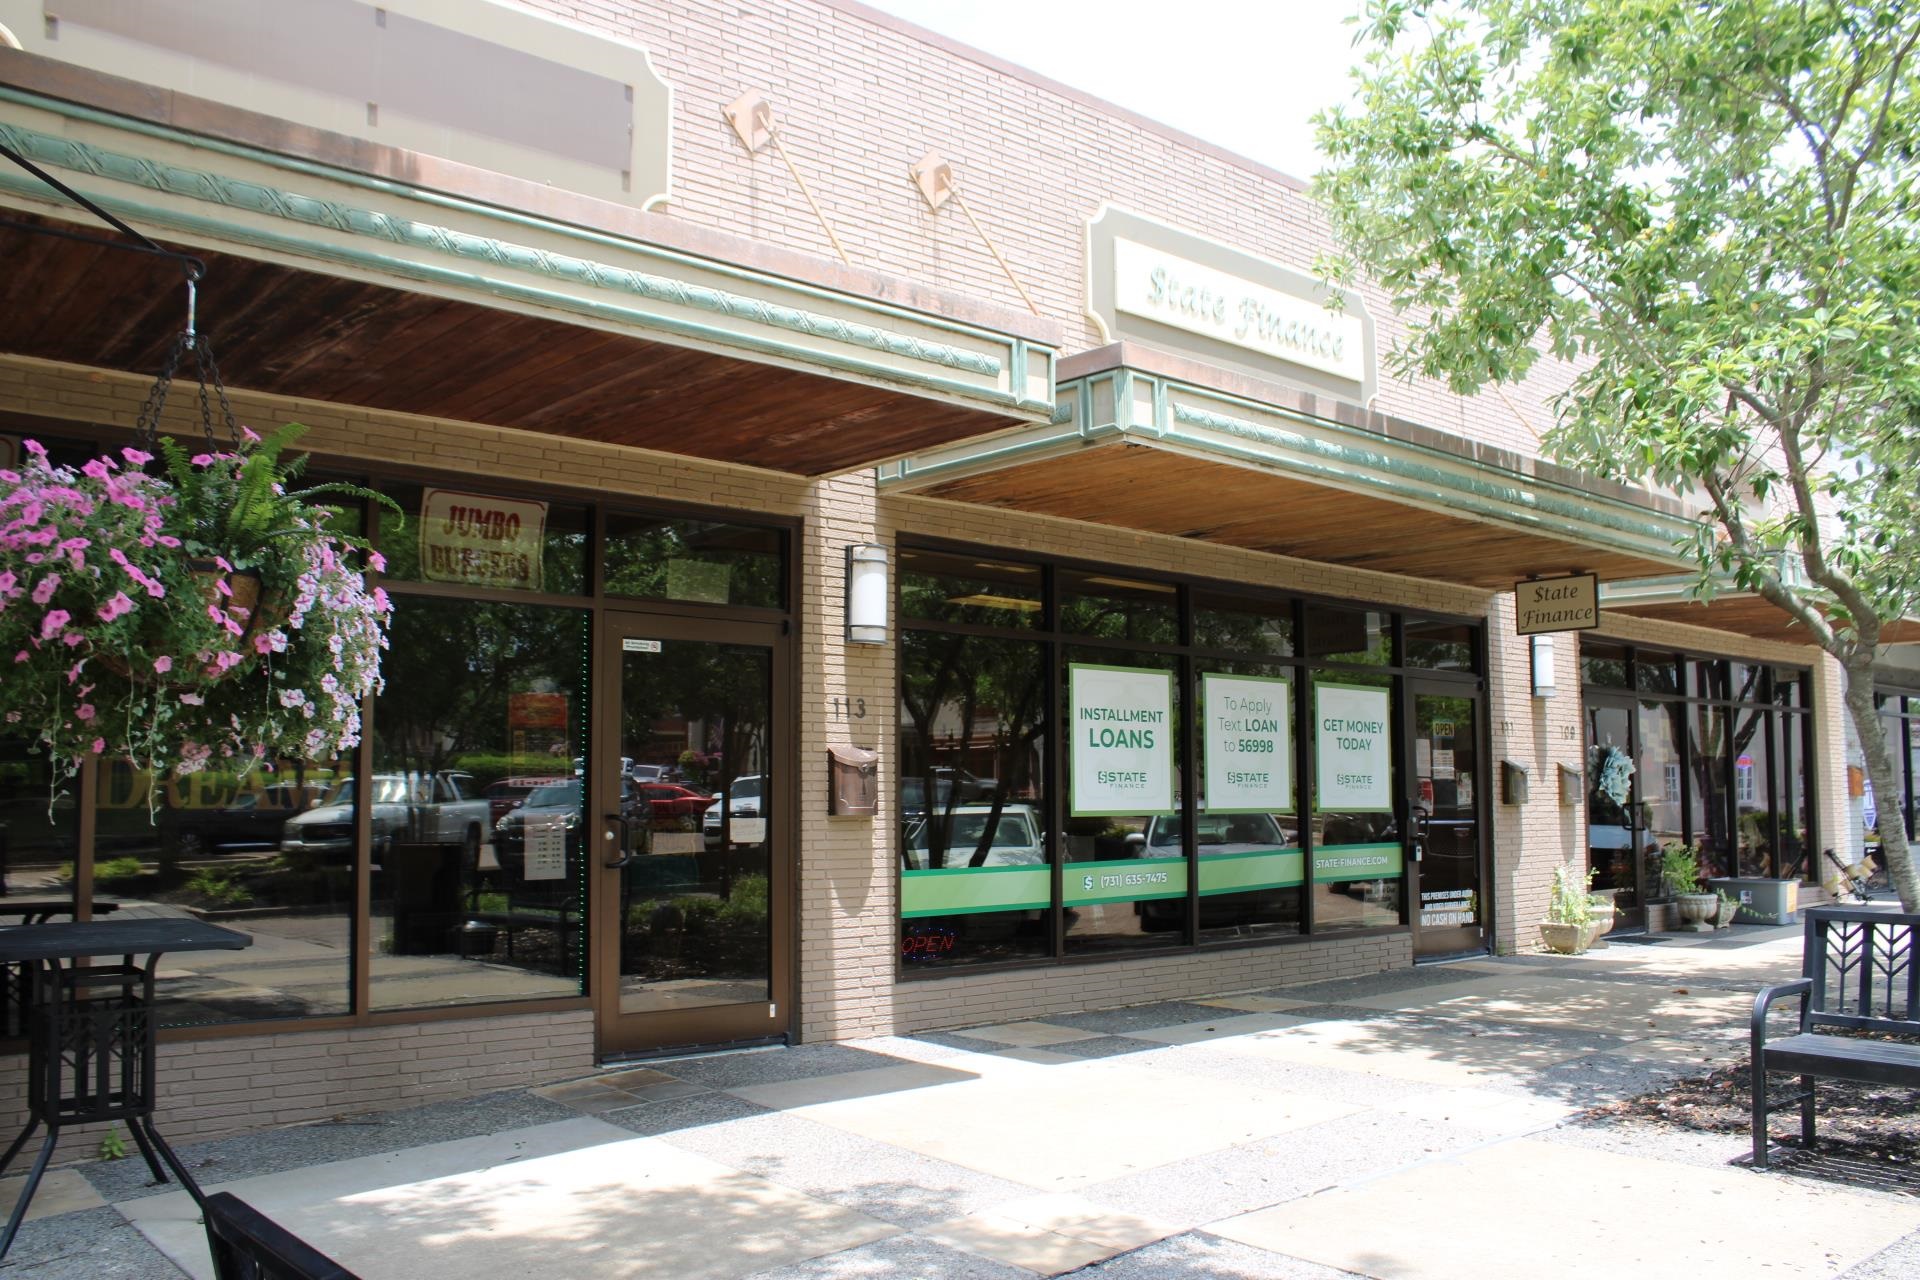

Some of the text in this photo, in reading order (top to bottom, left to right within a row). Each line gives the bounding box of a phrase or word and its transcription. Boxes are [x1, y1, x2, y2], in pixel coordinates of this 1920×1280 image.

[1234, 297, 1344, 362] Finance
[443, 505, 521, 542] JUMBO
[1521, 607, 1593, 629] Finance
[833, 697, 866, 721] 113
[1223, 696, 1272, 716] To Apply
[1080, 707, 1163, 723] INSTALLMENT
[1217, 717, 1278, 733] Text LOAN
[1323, 718, 1384, 734] GET MONEY
[1434, 723, 1453, 735] OPEN
[1089, 727, 1154, 749] LOANS
[1224, 739, 1274, 753] to 56998
[1336, 737, 1372, 751] TODAY
[1108, 772, 1147, 782] STATE
[1236, 773, 1269, 782] STATE
[1344, 774, 1373, 784] STATE
[1100, 874, 1123, 889] (731)
[1125, 872, 1168, 885] 635-7475
[1421, 911, 1474, 926] NO CASH ON HAND
[902, 936, 954, 953] OPEN
